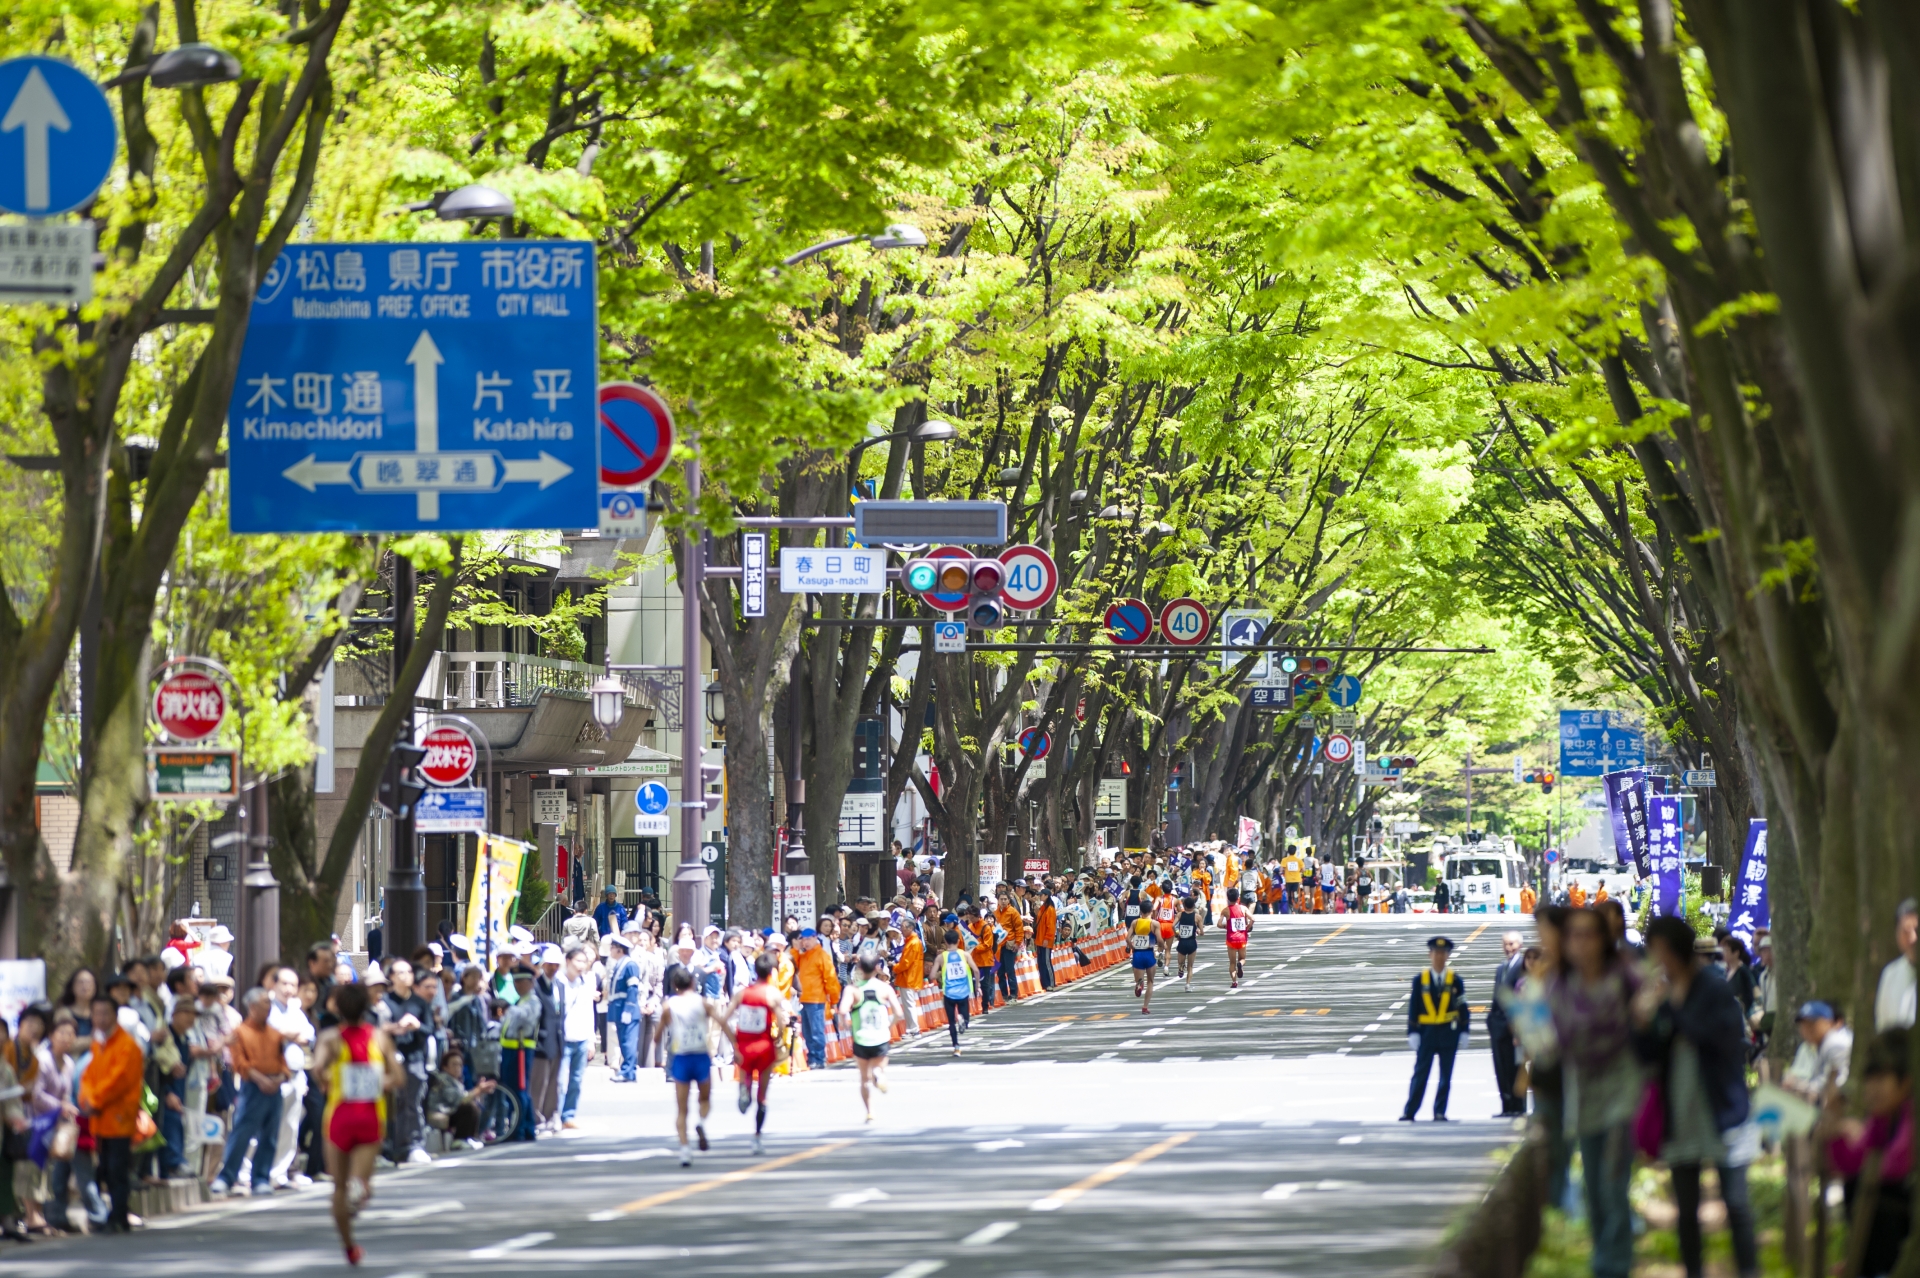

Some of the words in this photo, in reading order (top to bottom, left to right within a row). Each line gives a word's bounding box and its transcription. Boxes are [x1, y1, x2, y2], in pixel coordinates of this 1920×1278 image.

[296, 249, 366, 293] 松島
[389, 249, 460, 291] 県庁
[481, 246, 585, 290] 市役所
[293, 297, 372, 320] Matsushima
[377, 294, 418, 319] PREF.
[421, 294, 471, 319] OFFICE
[496, 293, 529, 318] CITY
[532, 292, 570, 318] HALL
[245, 371, 384, 416] 木町通
[473, 368, 573, 413] 片平
[243, 416, 383, 441] Kimachidori
[473, 418, 574, 442] Katahira
[796, 556, 871, 574] 春日町
[798, 575, 869, 587] Kasuga-machi
[1007, 564, 1042, 592] 40
[1172, 611, 1199, 633] 40
[160, 690, 221, 721] 消火栓
[1254, 689, 1286, 703] 空車
[1331, 742, 1346, 755] 40
[1025, 861, 1048, 870] お知らせ
[950, 967, 964, 976] 185
